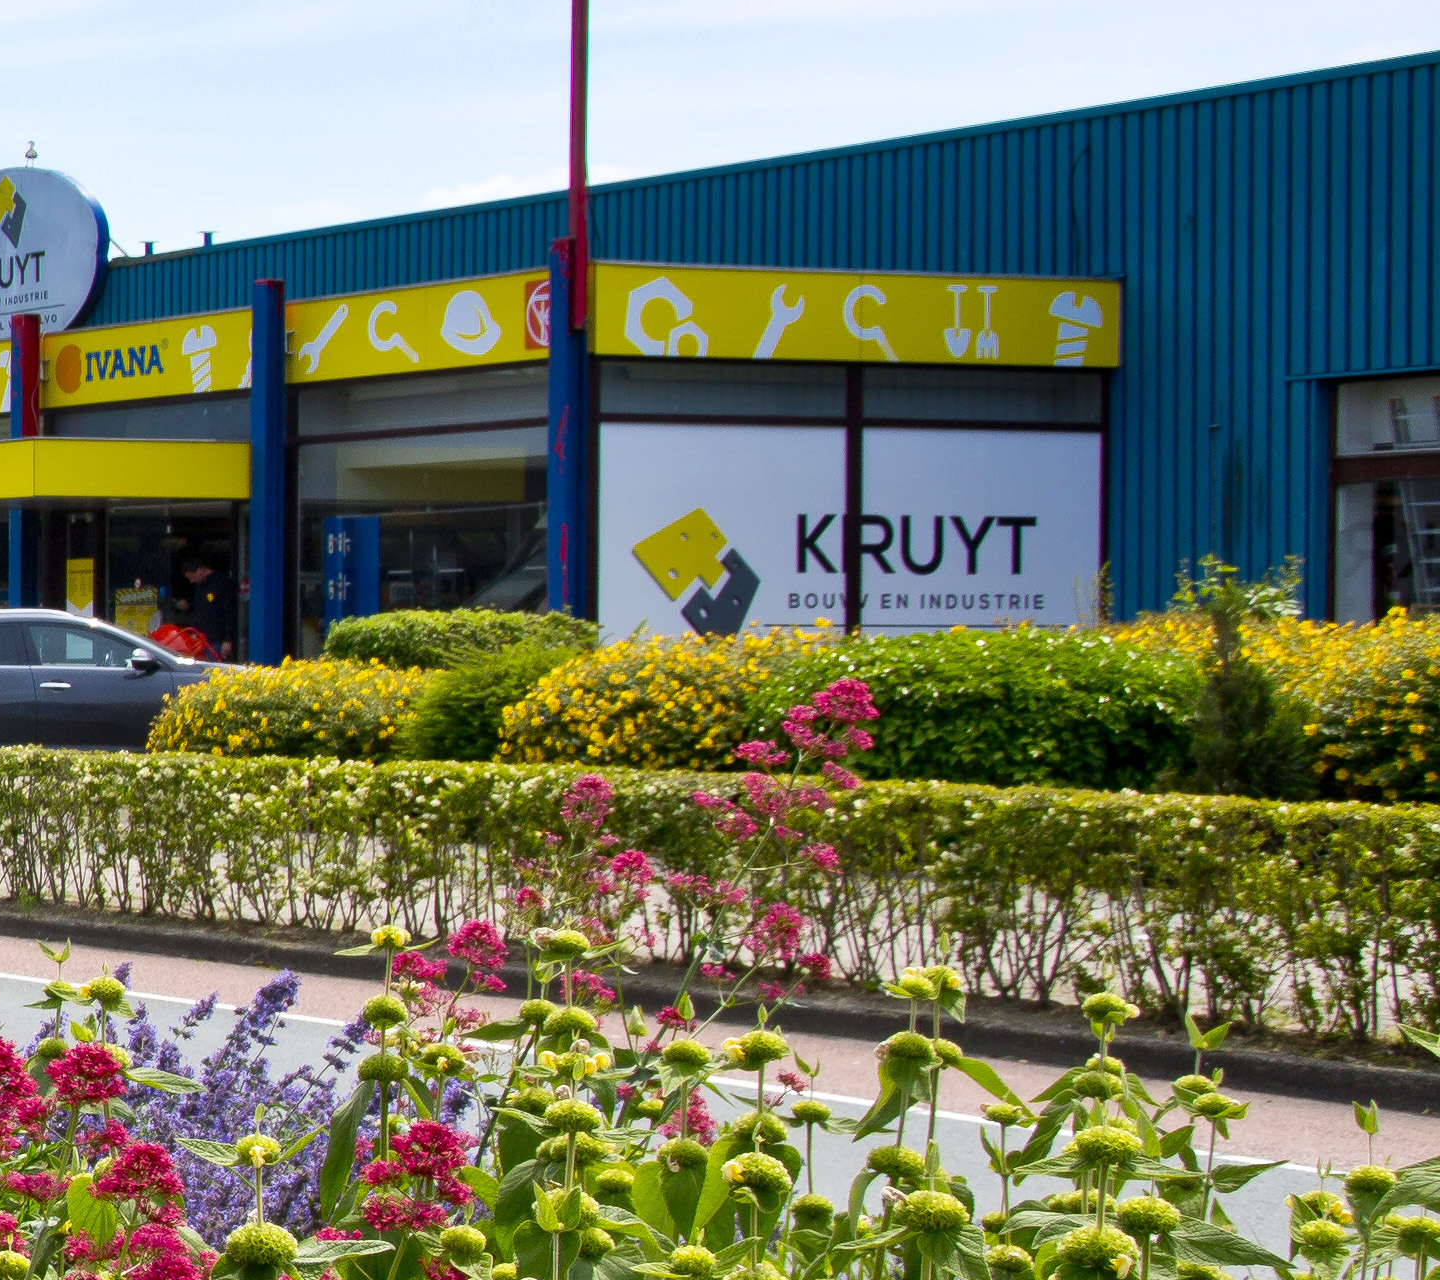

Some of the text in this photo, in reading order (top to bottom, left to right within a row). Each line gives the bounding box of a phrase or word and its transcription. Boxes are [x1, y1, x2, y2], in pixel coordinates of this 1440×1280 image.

[5, 290, 49, 306] INDUSTRIE
[795, 513, 1038, 575] KRUYT
[880, 593, 911, 609] EN
[920, 593, 1045, 610] INDUSTRIE
